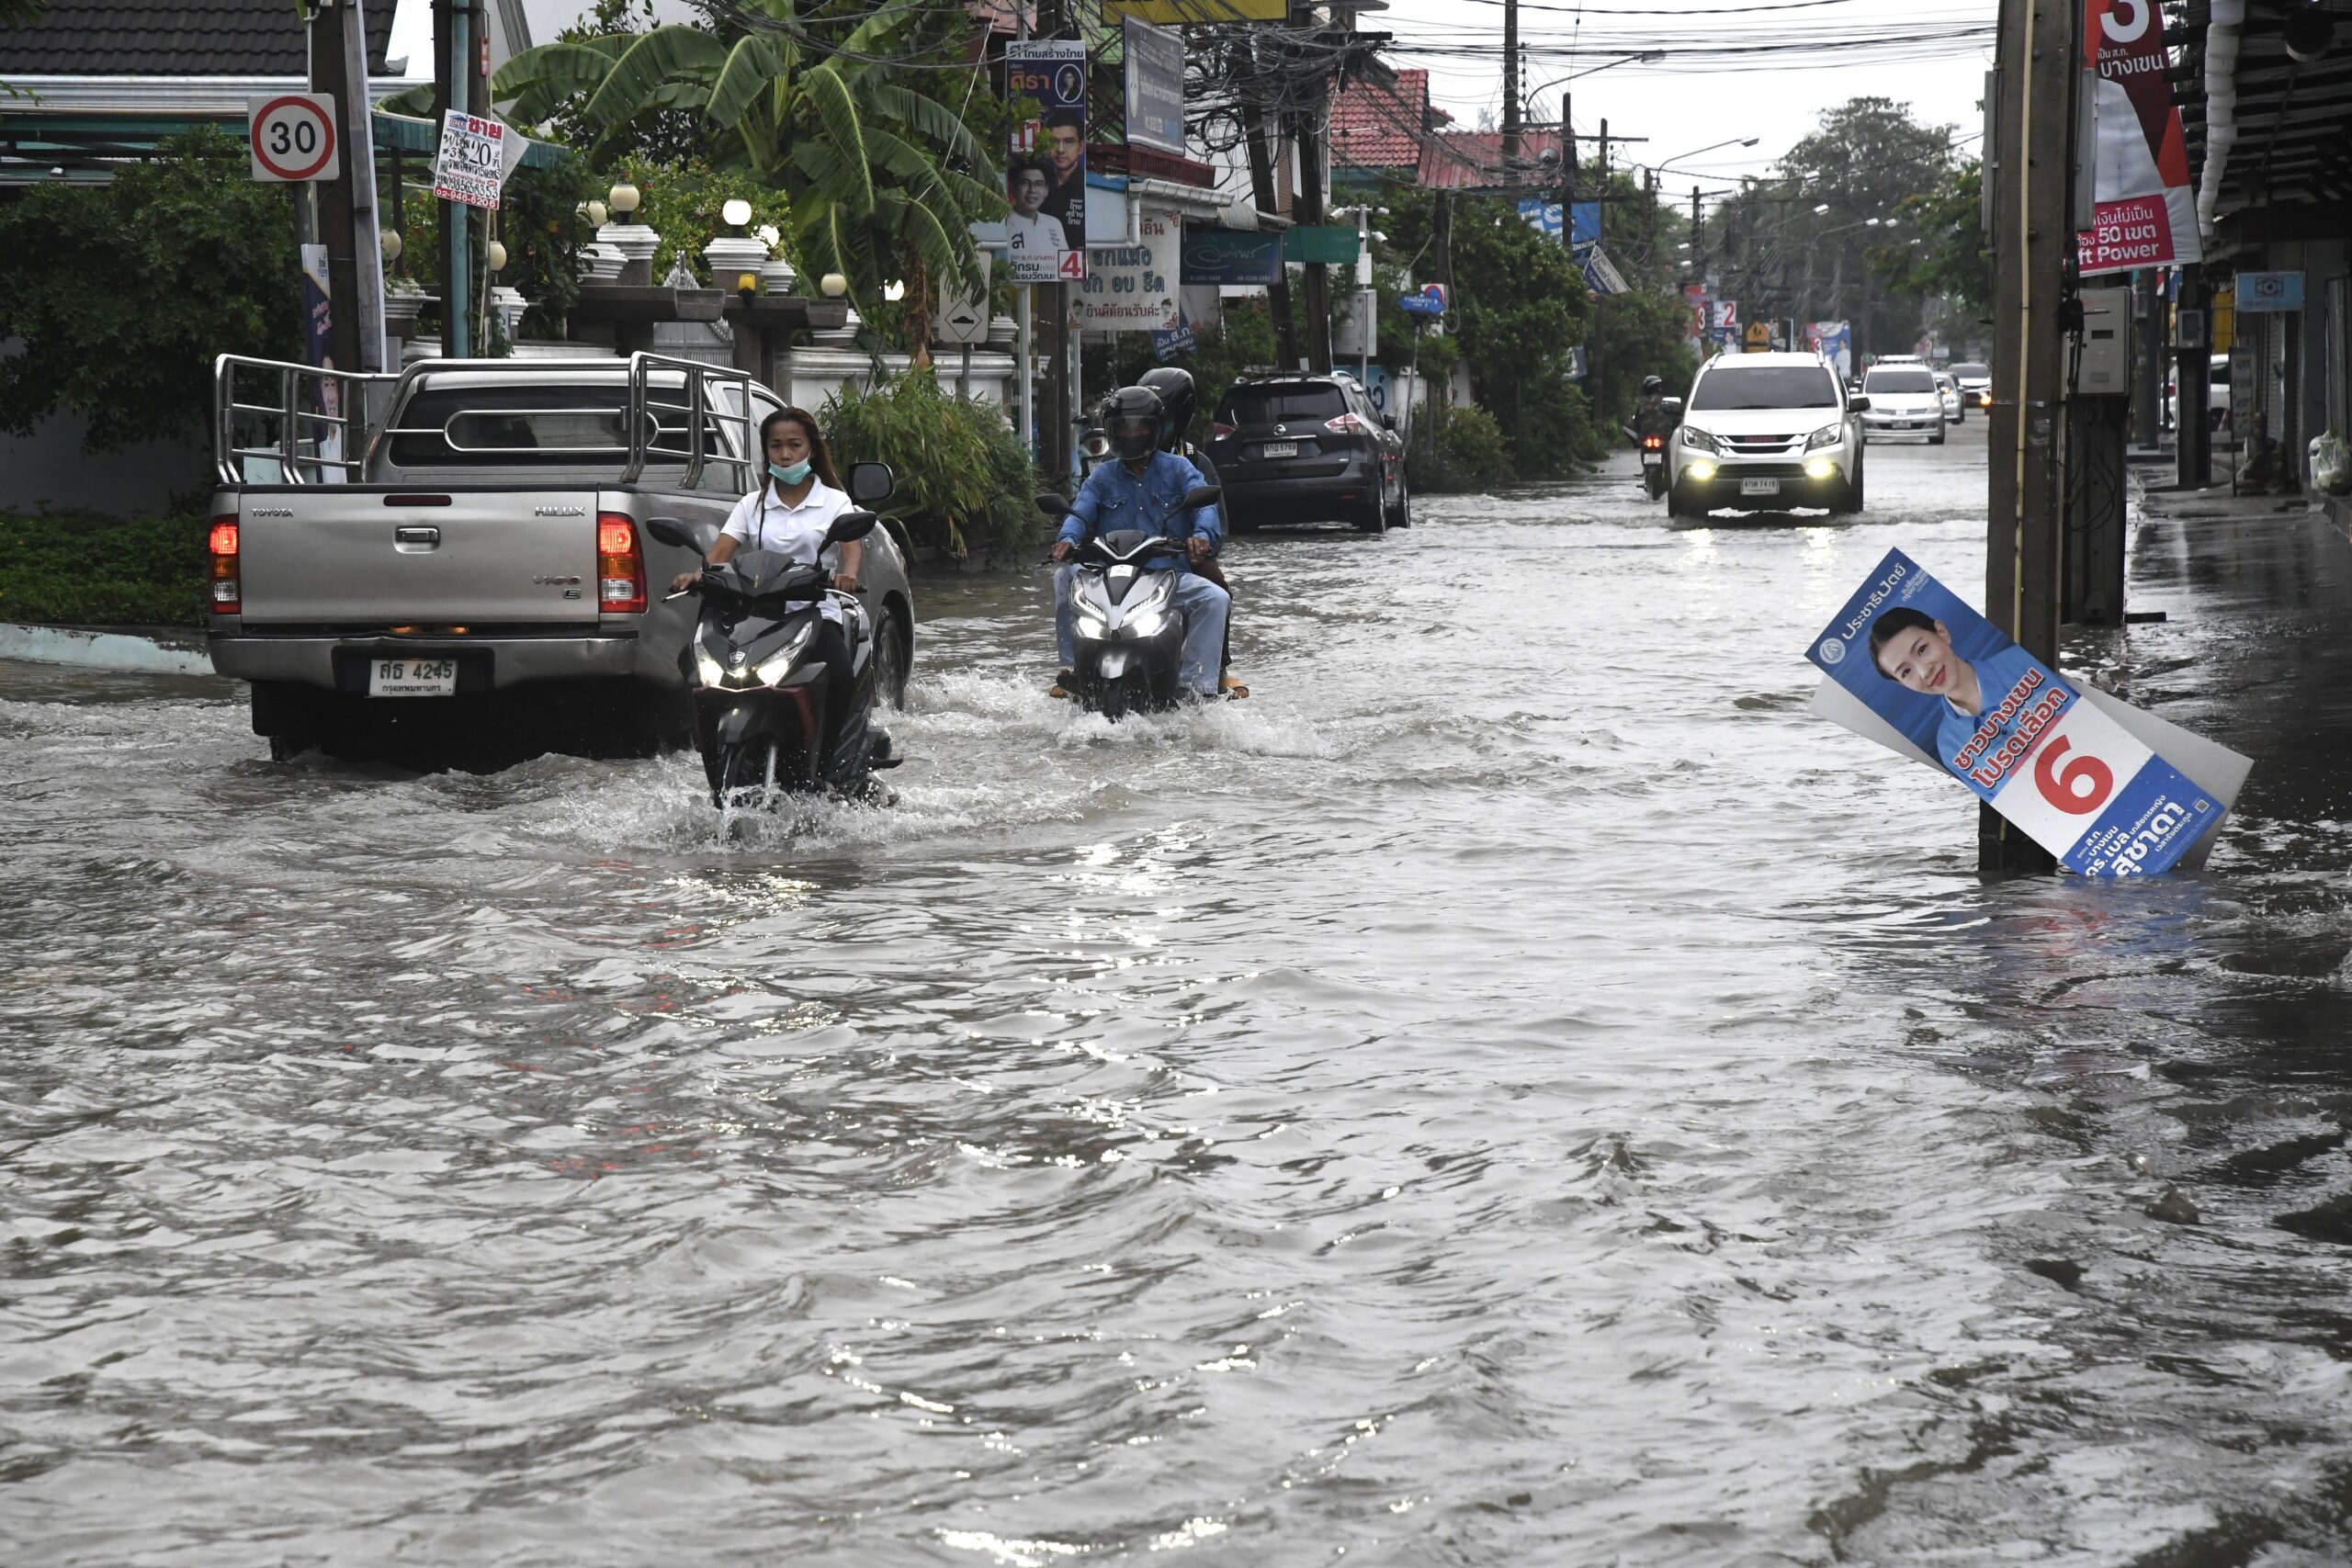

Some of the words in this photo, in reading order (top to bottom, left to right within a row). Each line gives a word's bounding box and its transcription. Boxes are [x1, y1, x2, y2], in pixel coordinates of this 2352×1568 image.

[1024, 48, 1083, 58] ไทยสร้างไทย
[2100, 54, 2165, 77] บางเขน
[270, 120, 316, 154] 30
[469, 118, 503, 140] ขาย
[435, 189, 496, 208] 02-946-6206
[2098, 226, 2121, 244] 50
[2124, 224, 2157, 242] เขต
[1060, 252, 1081, 276] 4
[2098, 243, 2159, 263] Power
[1112, 276, 1135, 293] อบ
[1143, 271, 1165, 293] รีด
[1086, 302, 1160, 318] ยินดีต้อนรับค่ะ
[1724, 303, 1736, 326] 2
[1170, 327, 1193, 342] ส.ก.
[251, 508, 294, 517] TOYOTA
[536, 506, 585, 516] HILUX
[533, 575, 581, 585] VIGO
[1842, 562, 1906, 640] ประชาธิปัตย์
[413, 662, 453, 680] 4245
[382, 684, 441, 694] กรุงเทพมหานคร
[1953, 667, 2044, 770] ชาวบางเขน
[1970, 687, 2069, 789] โปรดเลือก
[2034, 734, 2113, 815] 6
[2104, 831, 2131, 858] เบล
[2130, 795, 2166, 835] เภสัชกรหญิง
[2086, 829, 2102, 847] ส.ก.
[2088, 826, 2120, 857] บางเขน
[2110, 801, 2186, 876] สุชาดา
